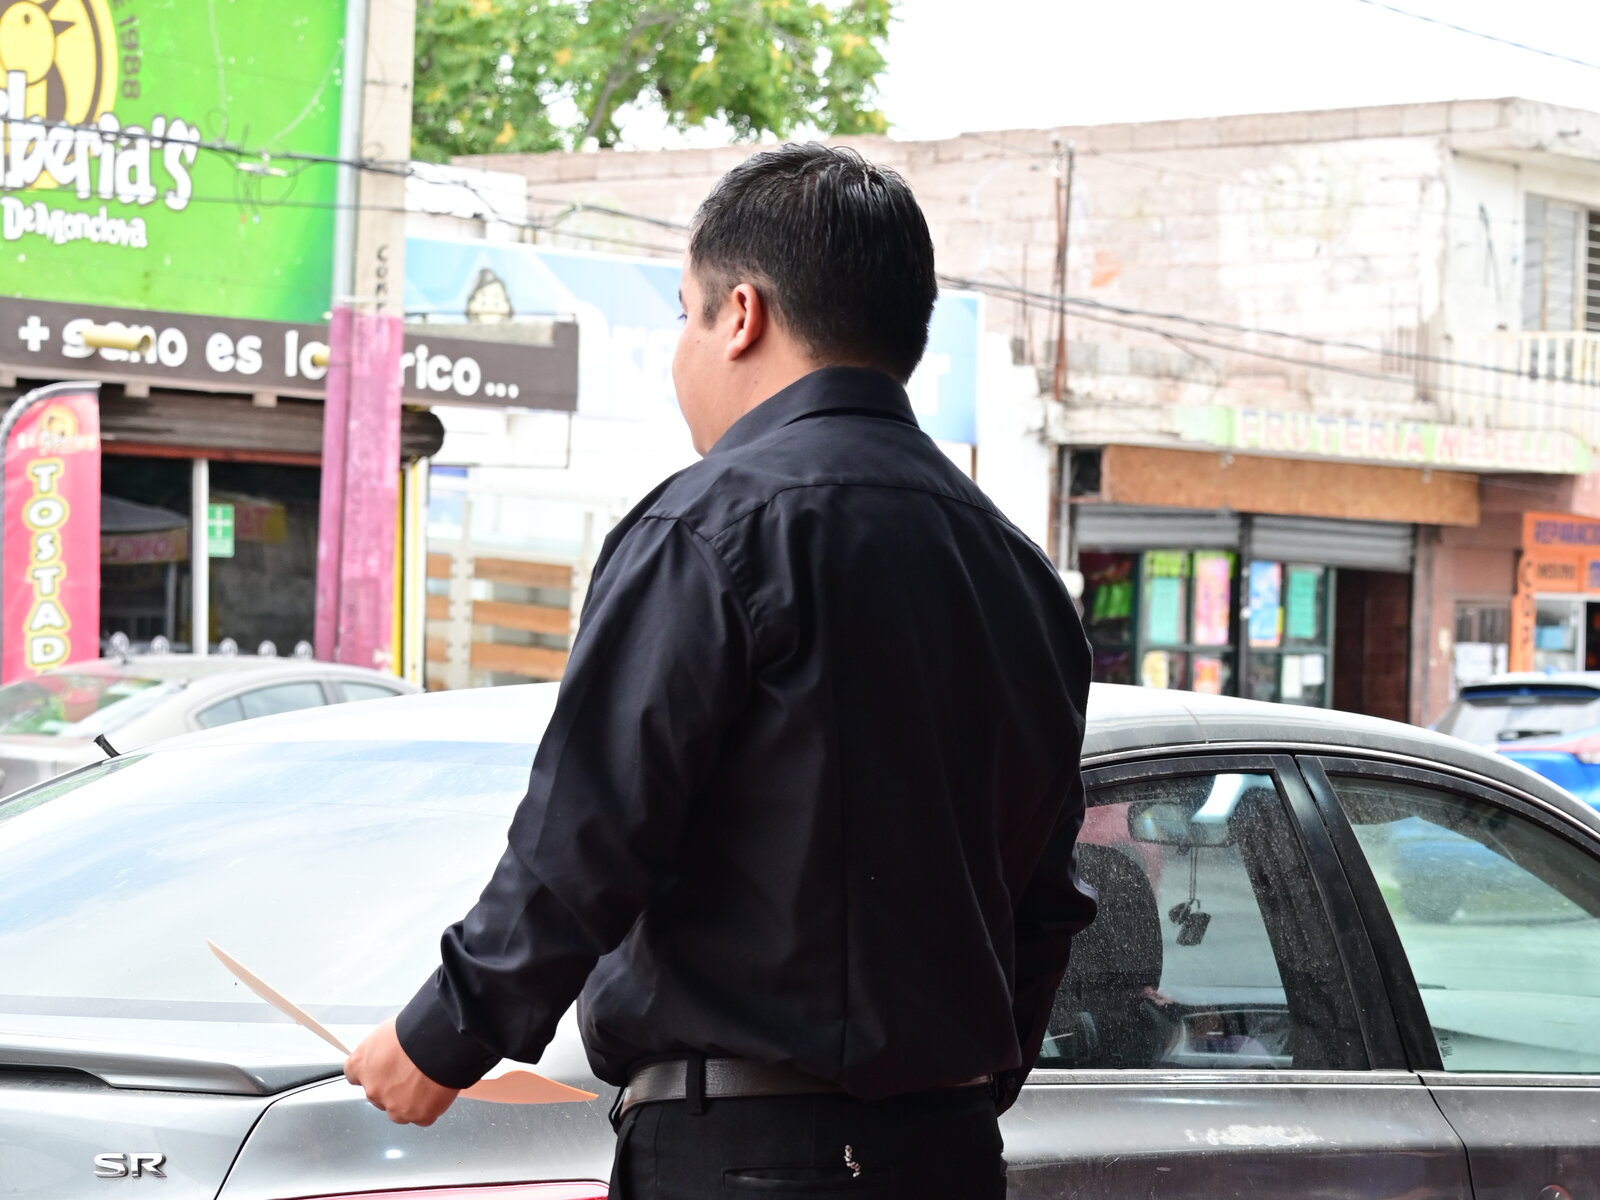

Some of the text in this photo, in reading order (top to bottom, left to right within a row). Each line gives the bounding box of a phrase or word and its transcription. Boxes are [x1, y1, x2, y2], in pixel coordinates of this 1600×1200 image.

[118, 15, 141, 99] 1988
[206, 332, 262, 375] es
[284, 330, 330, 379] lo
[1241, 408, 1425, 461] FRUTERIA
[27, 463, 68, 675] TOSTAD
[93, 1152, 167, 1178] SR
